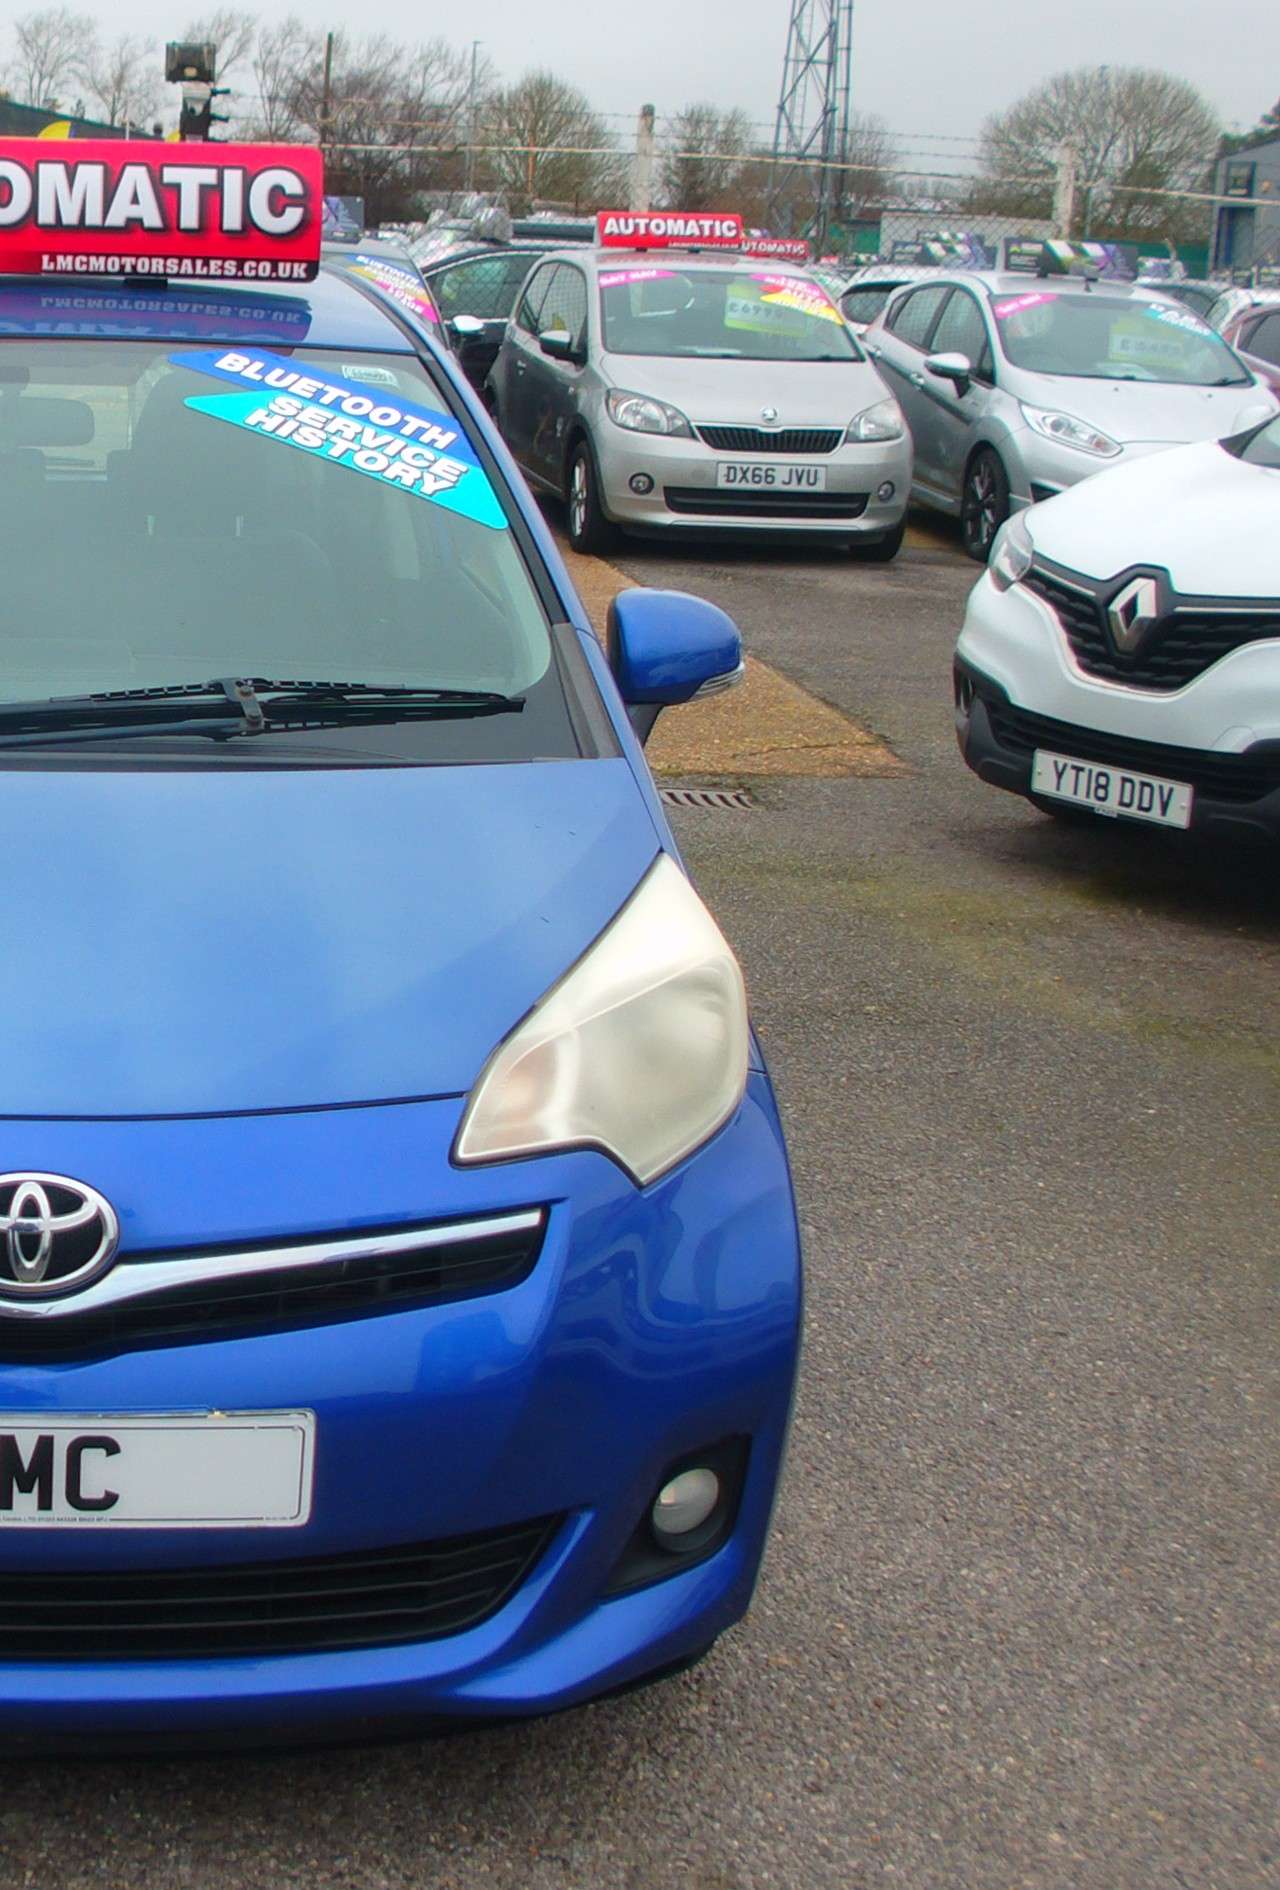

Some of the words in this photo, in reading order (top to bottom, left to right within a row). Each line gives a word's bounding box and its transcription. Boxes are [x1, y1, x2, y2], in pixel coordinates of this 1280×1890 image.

[604, 217, 738, 238] AUTOMATIC
[741, 240, 806, 255] UTOMATIC
[41, 254, 308, 279] LMCMOTORSALES.CO.UK
[214, 353, 458, 450] BLUETOOTH
[244, 408, 455, 497] HISTORY
[268, 396, 469, 482] SERVICE
[724, 465, 776, 485] DX66
[782, 468, 818, 487] JVU
[1053, 759, 1111, 803] YT18
[1117, 775, 1174, 818] DDV
